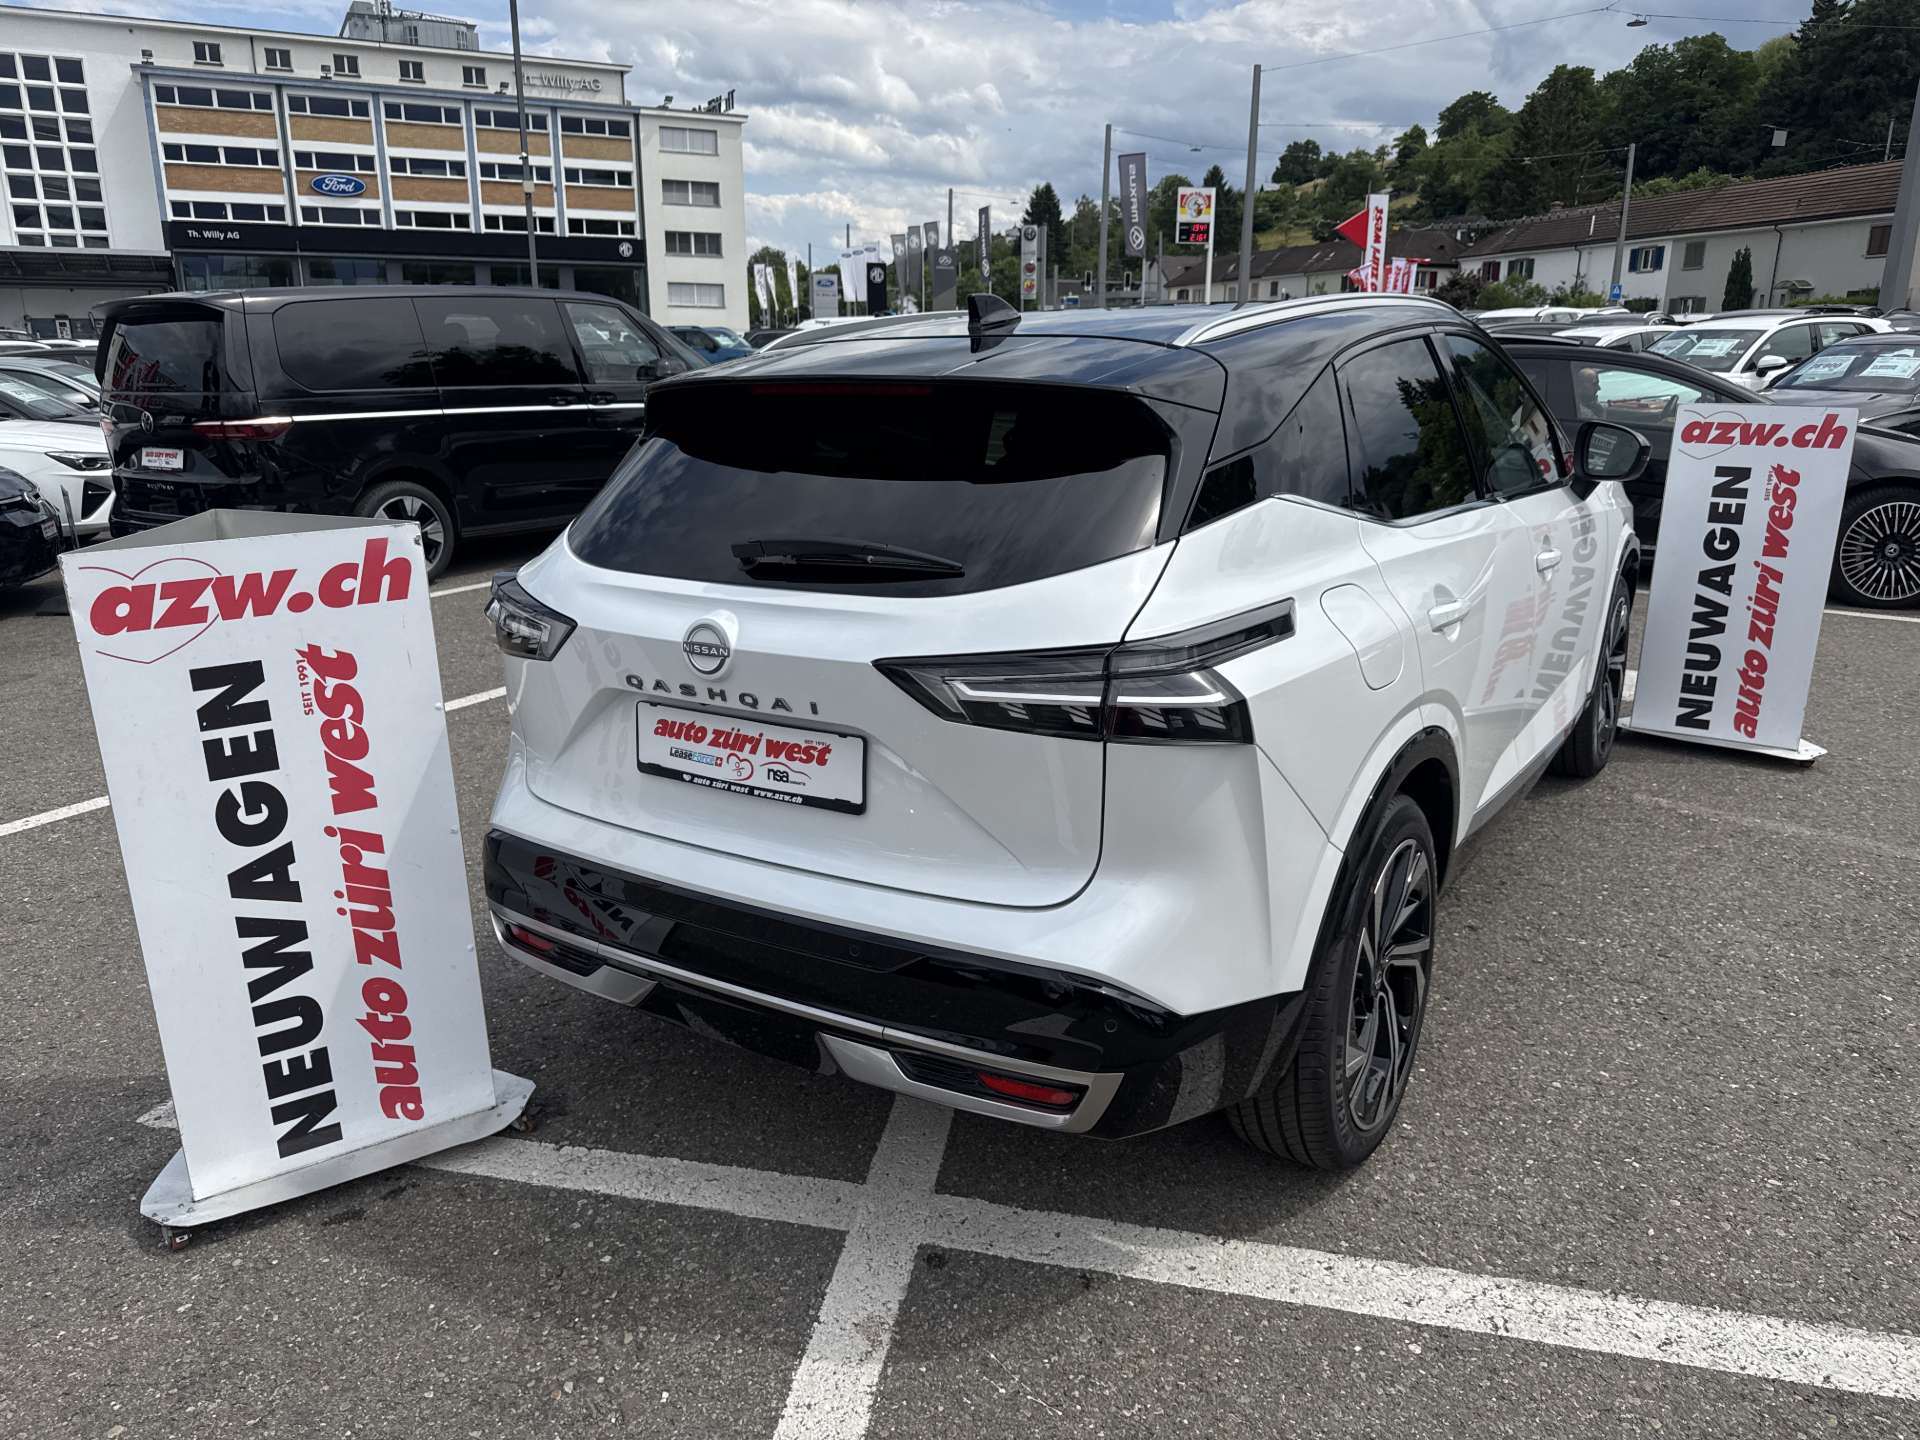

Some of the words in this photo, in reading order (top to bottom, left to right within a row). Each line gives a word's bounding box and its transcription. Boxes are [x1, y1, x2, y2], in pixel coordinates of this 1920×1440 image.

[541, 71, 575, 92] Willy
[580, 78, 602, 92] AG
[322, 176, 355, 192] Ford
[187, 229, 201, 238] Th.
[202, 230, 224, 241] Willy
[226, 231, 240, 240] AG
[1681, 412, 1848, 450] azw.ch
[1762, 463, 1801, 558] west
[89, 537, 412, 636] azw.ch
[1675, 466, 1752, 731] NEUWAGEN
[1745, 560, 1784, 650] züri
[296, 658, 311, 688] 1991
[682, 642, 730, 658] NISSAN
[302, 690, 315, 716] SEIT
[625, 673, 820, 716] QASHQAI
[1733, 651, 1768, 740] auto
[295, 642, 378, 816] west
[653, 718, 708, 744] auto
[707, 727, 764, 755] züri
[765, 738, 833, 767] west
[693, 776, 711, 787] auto
[712, 779, 729, 791] züri
[730, 784, 750, 794] west
[754, 788, 803, 804] www.azw.ch
[767, 767, 790, 783] nsa
[189, 659, 343, 1158] NEUWAGEN
[324, 826, 402, 970] züri
[355, 977, 424, 1121] auto
